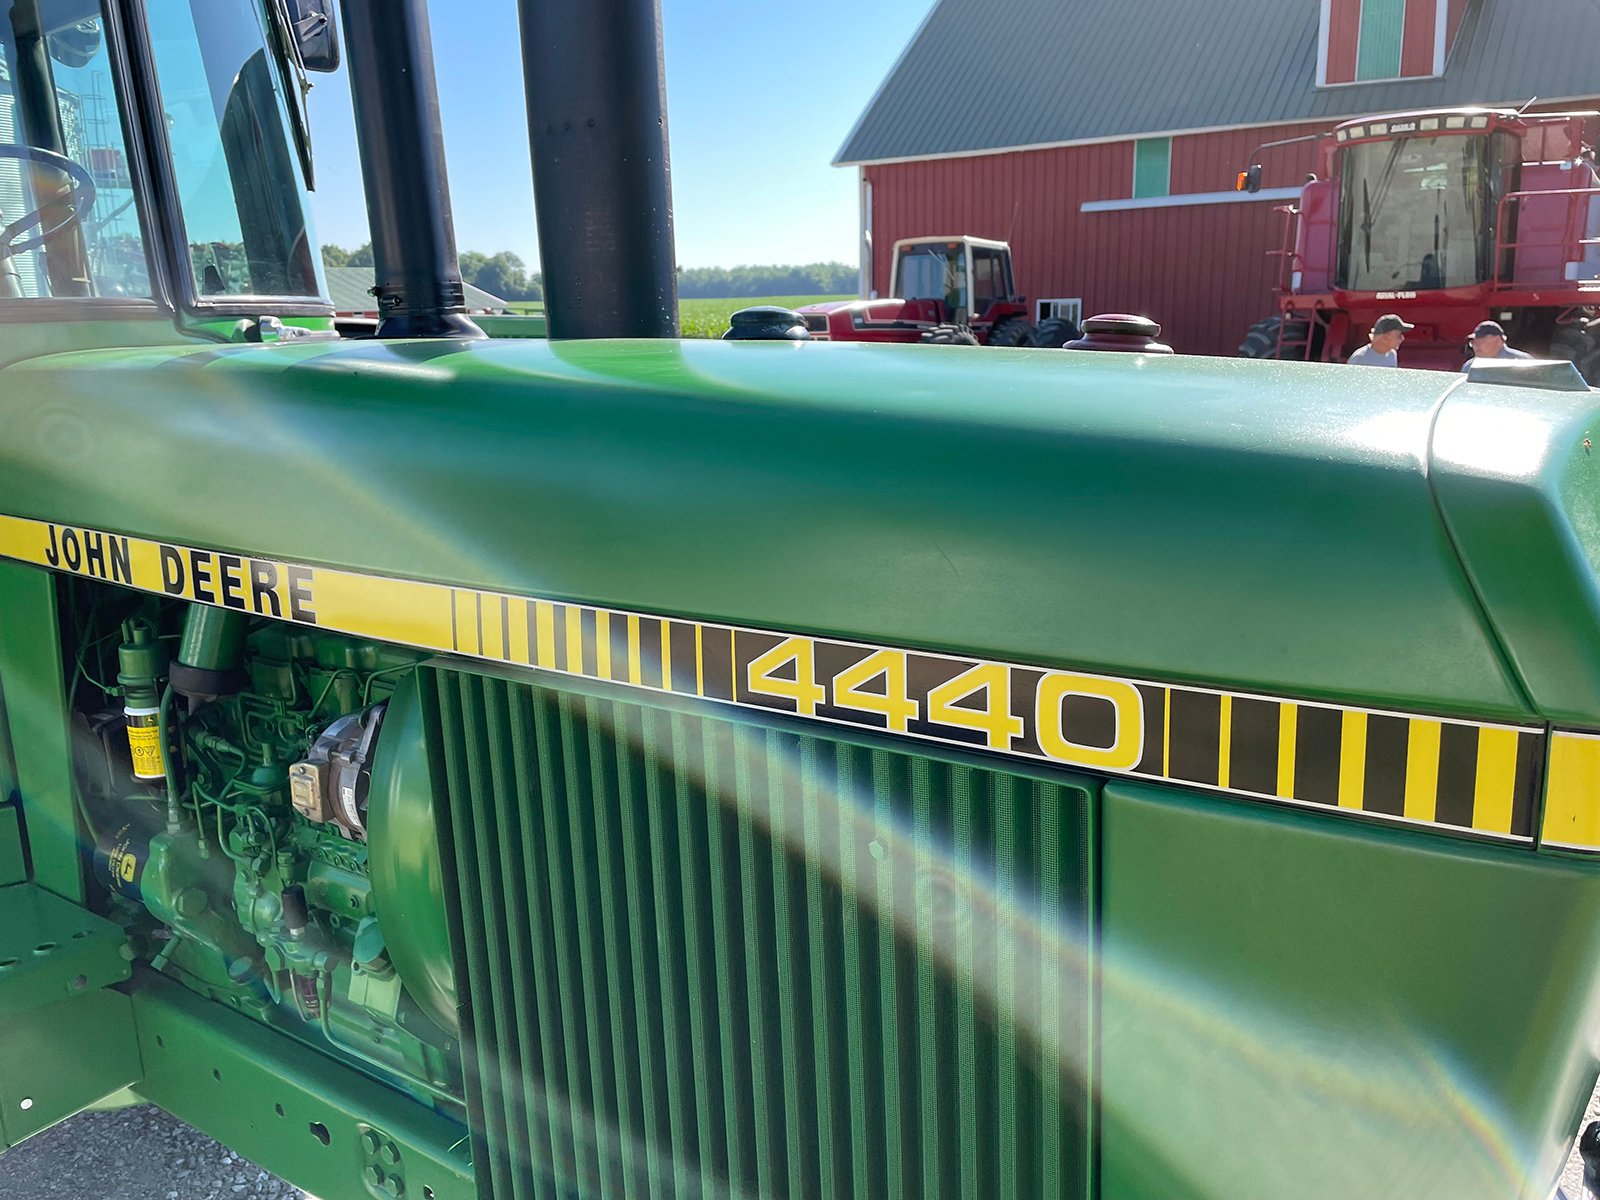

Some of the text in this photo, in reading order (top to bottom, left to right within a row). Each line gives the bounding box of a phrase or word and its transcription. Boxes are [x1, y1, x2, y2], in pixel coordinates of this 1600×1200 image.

[45, 525, 317, 624] JOHN DEERE
[747, 636, 1145, 772] 4440
